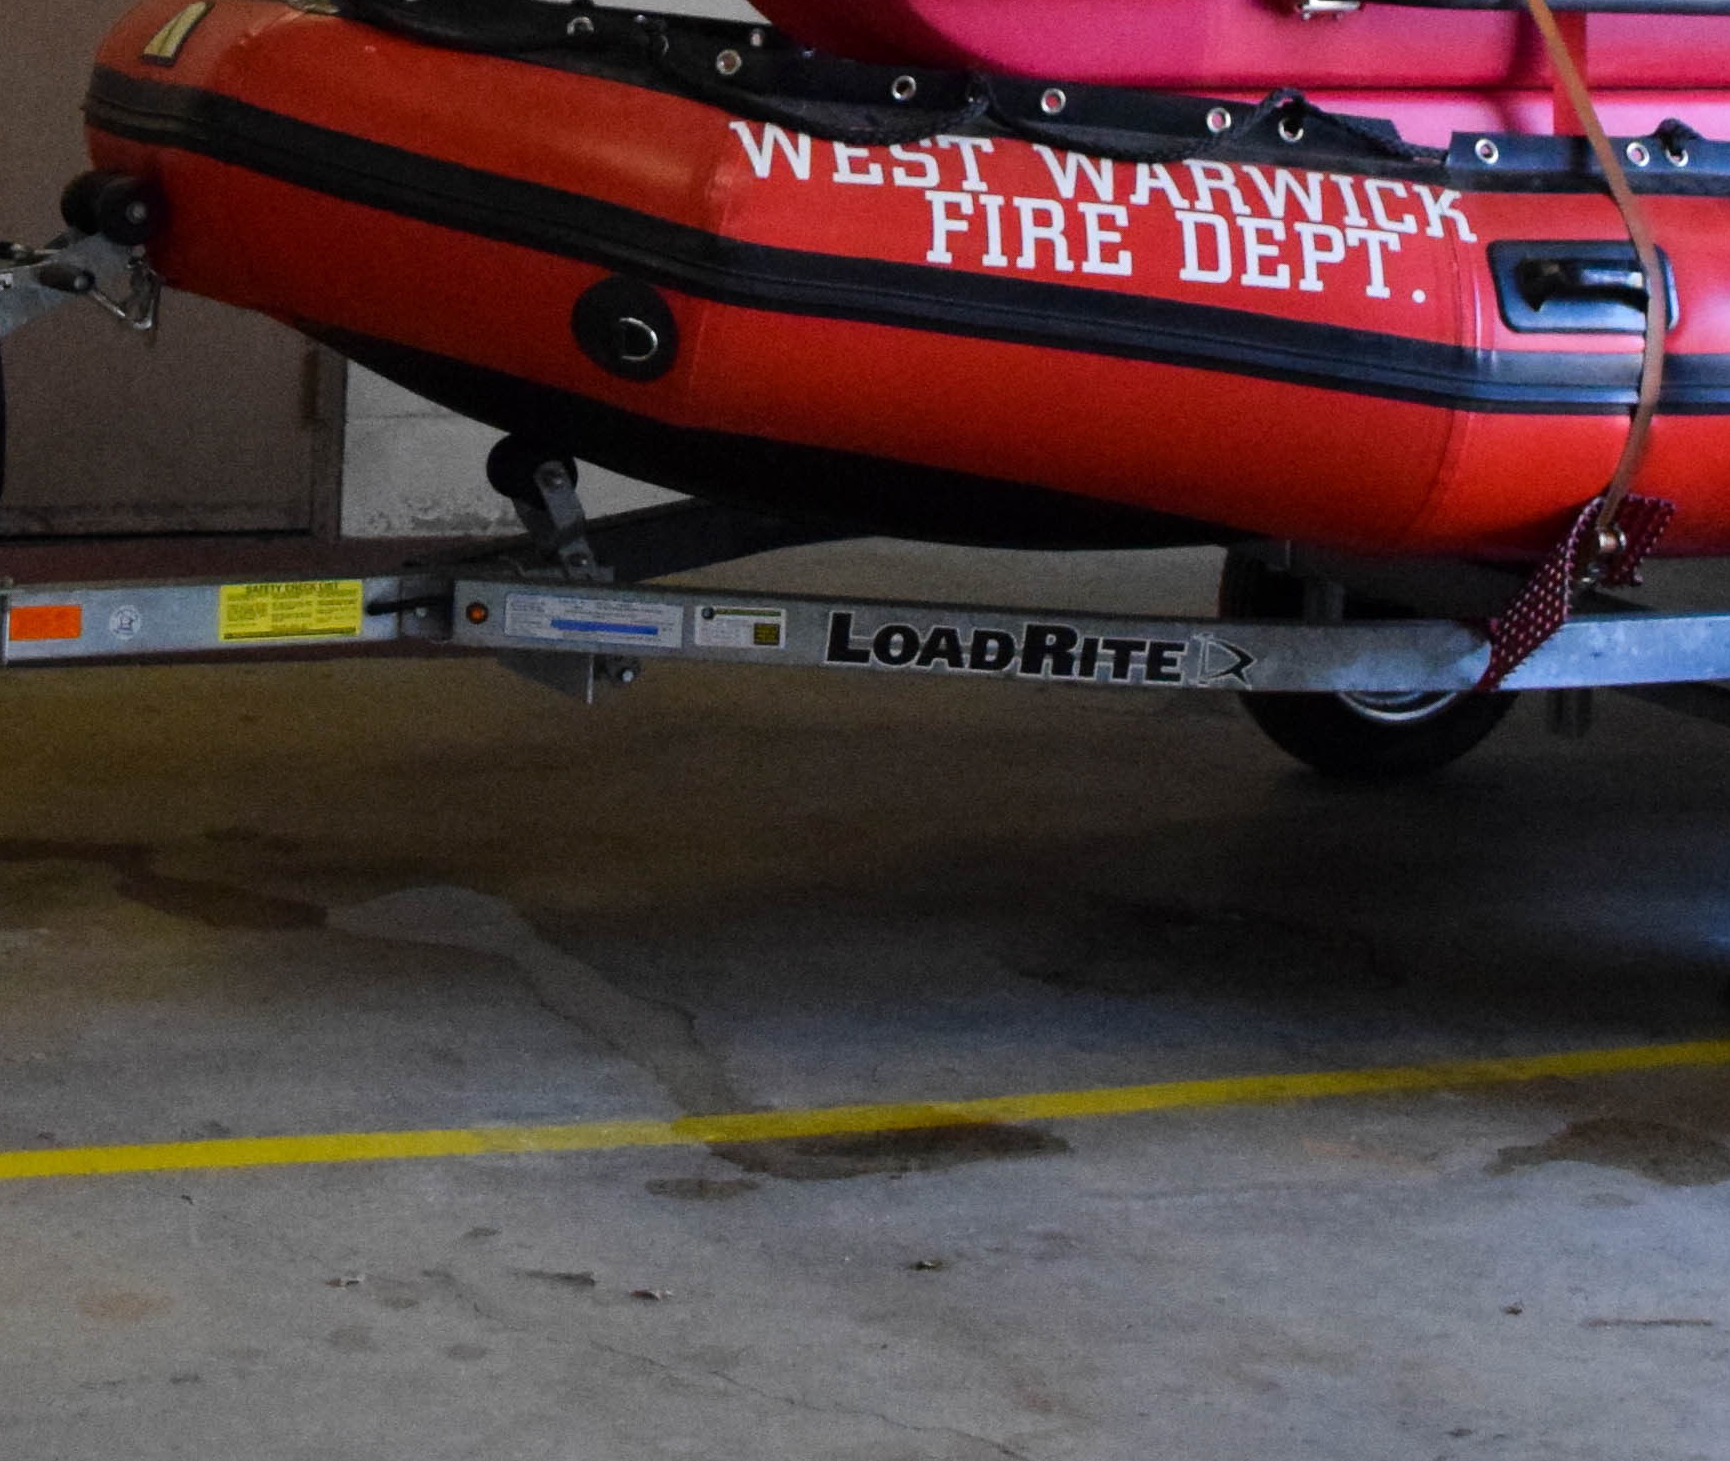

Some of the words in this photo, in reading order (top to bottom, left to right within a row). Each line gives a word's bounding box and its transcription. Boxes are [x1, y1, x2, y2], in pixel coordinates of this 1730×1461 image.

[728, 119, 995, 193] WEST
[1033, 144, 1478, 243] WARWICK
[924, 190, 1133, 275] FIRE
[1176, 208, 1428, 303] DEPT.
